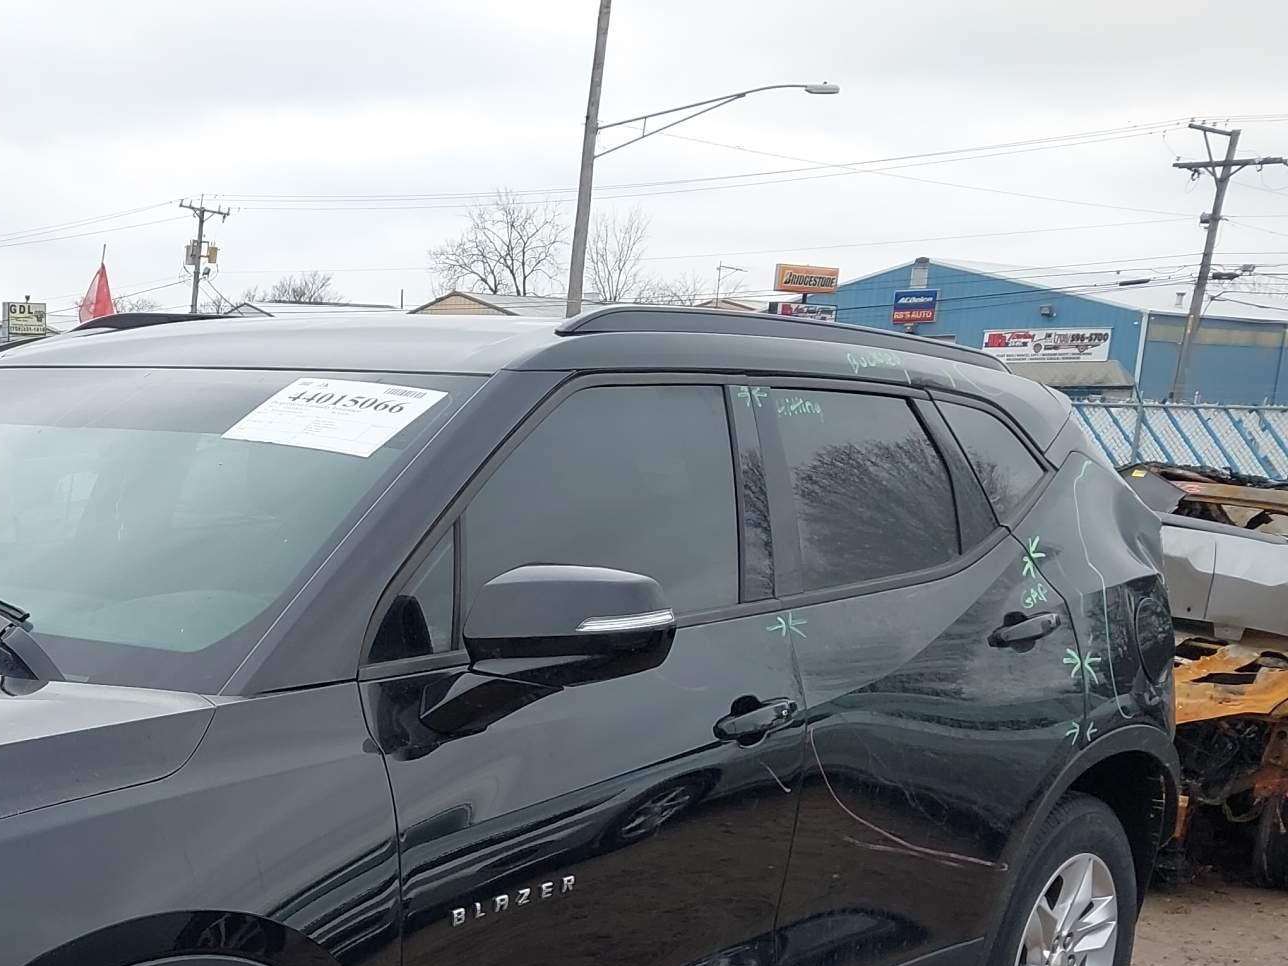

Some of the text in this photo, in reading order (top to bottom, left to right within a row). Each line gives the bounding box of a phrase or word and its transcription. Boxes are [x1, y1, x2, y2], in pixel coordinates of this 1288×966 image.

[784, 271, 836, 288] BRIDGESTONE
[897, 295, 934, 304] ACDelco
[9, 304, 34, 315] GDL
[911, 310, 933, 319] AUTO
[287, 390, 408, 414] 44015066
[451, 875, 576, 928] BLAZER
